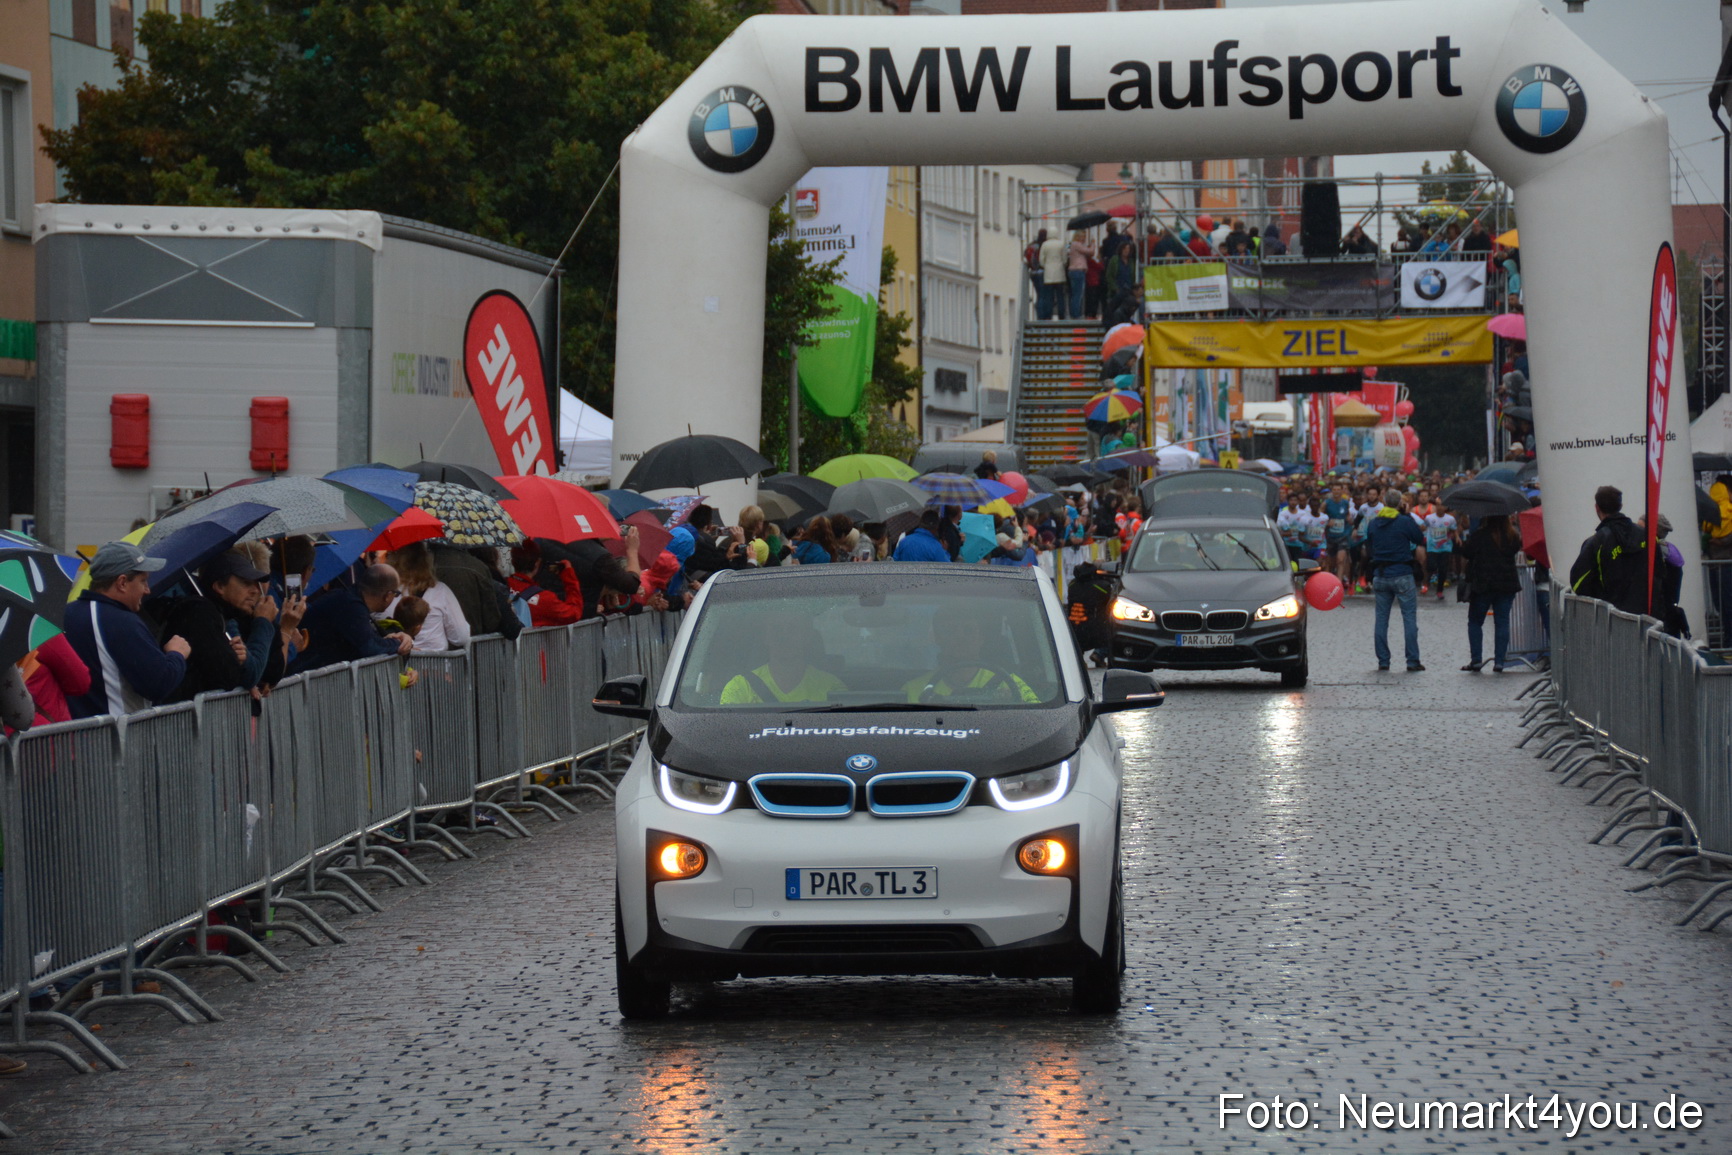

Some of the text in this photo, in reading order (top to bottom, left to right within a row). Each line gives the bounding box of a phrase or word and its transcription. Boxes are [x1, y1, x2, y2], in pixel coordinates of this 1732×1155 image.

[804, 35, 1463, 121] BMW Laufsport
[1504, 65, 1581, 97] BMW
[694, 86, 766, 120] BMW
[1281, 329, 1359, 357] ZIEL
[1649, 272, 1673, 484] REWE
[1549, 430, 1677, 451] www.bmw-laufsp.de
[1182, 634, 1234, 645] PAR TL 206
[749, 726, 981, 739] „Führungsfahrzeug“
[809, 870, 927, 896] PAR TL 3
